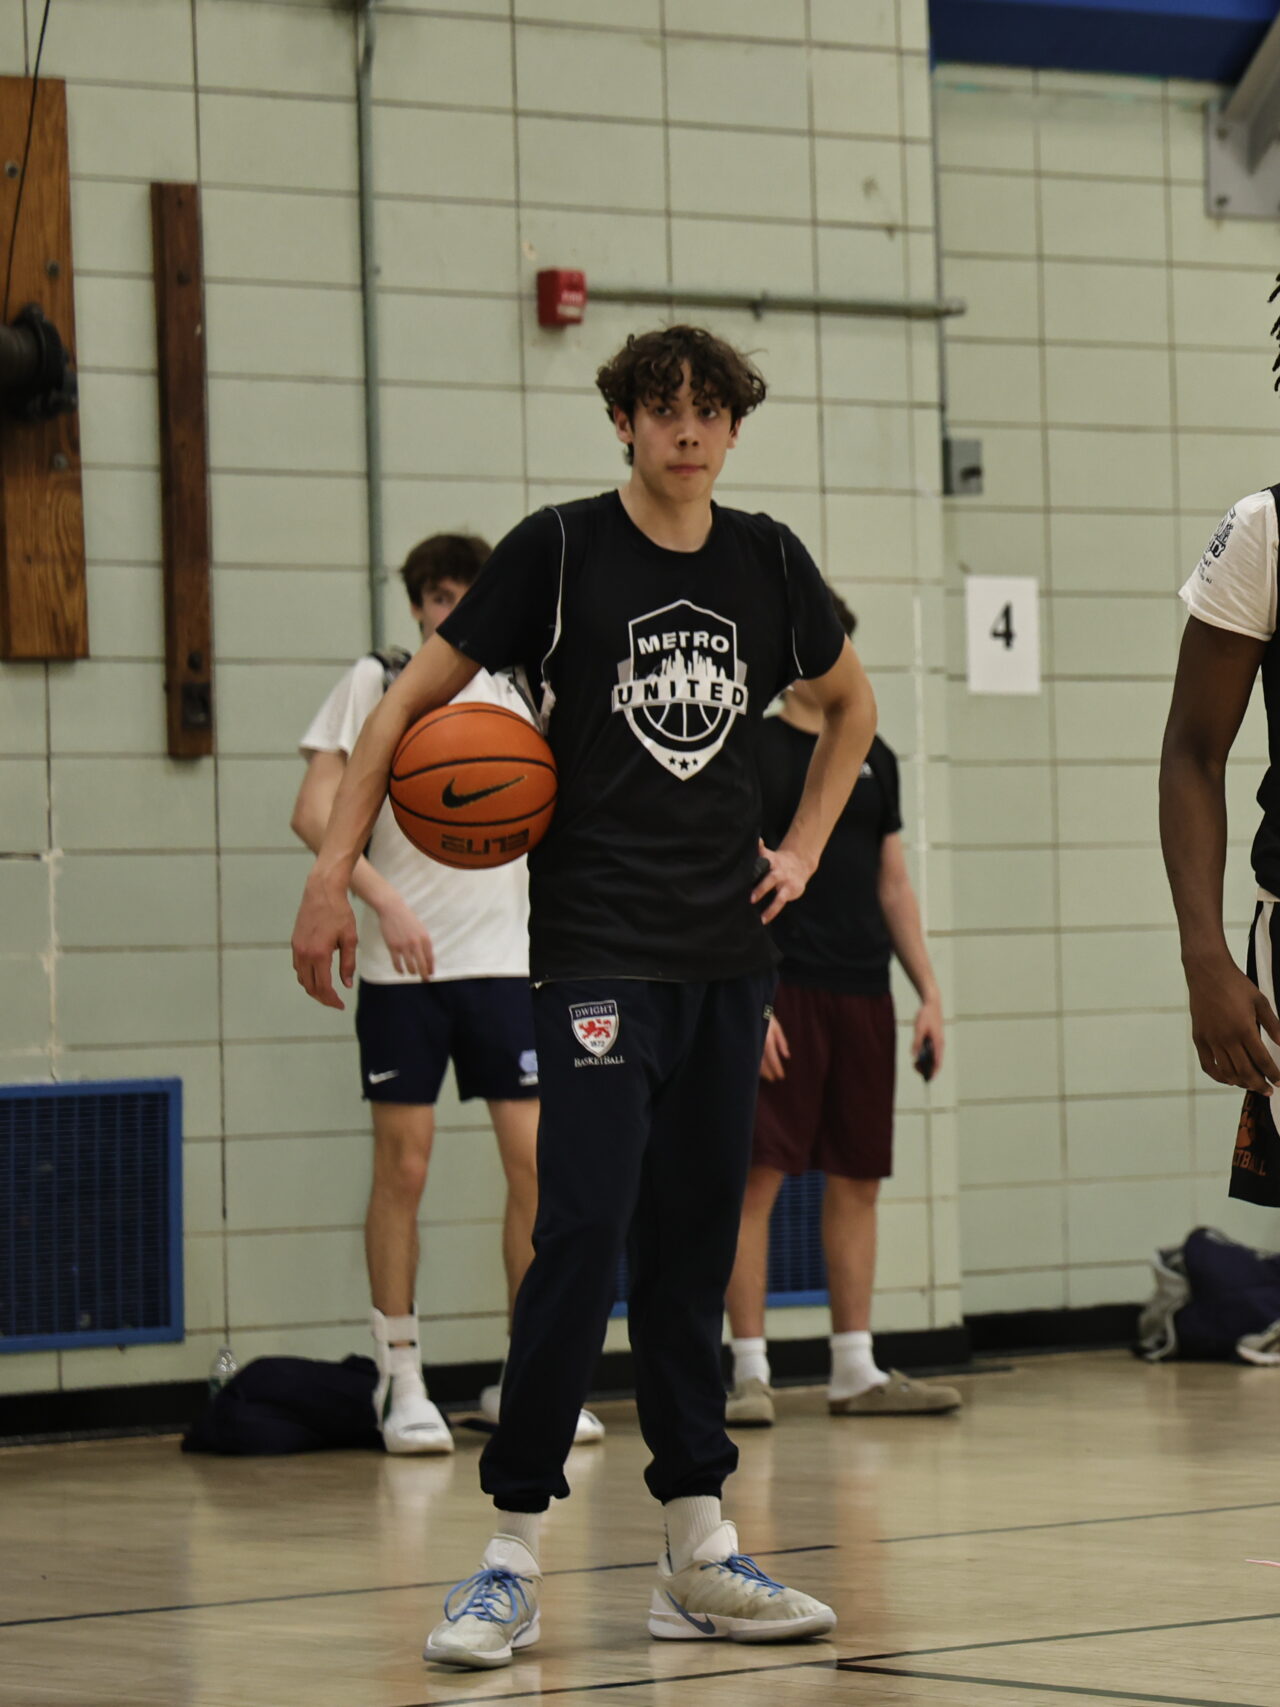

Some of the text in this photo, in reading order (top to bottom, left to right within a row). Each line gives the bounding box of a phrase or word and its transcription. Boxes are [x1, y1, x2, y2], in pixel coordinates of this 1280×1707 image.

[989, 600, 1016, 651] 4
[637, 631, 730, 655] METRO
[617, 679, 745, 707] UNITED
[441, 828, 530, 856] ELITE
[575, 1005, 613, 1017] DWIGHT
[575, 1056, 624, 1067] BASKETBALL
